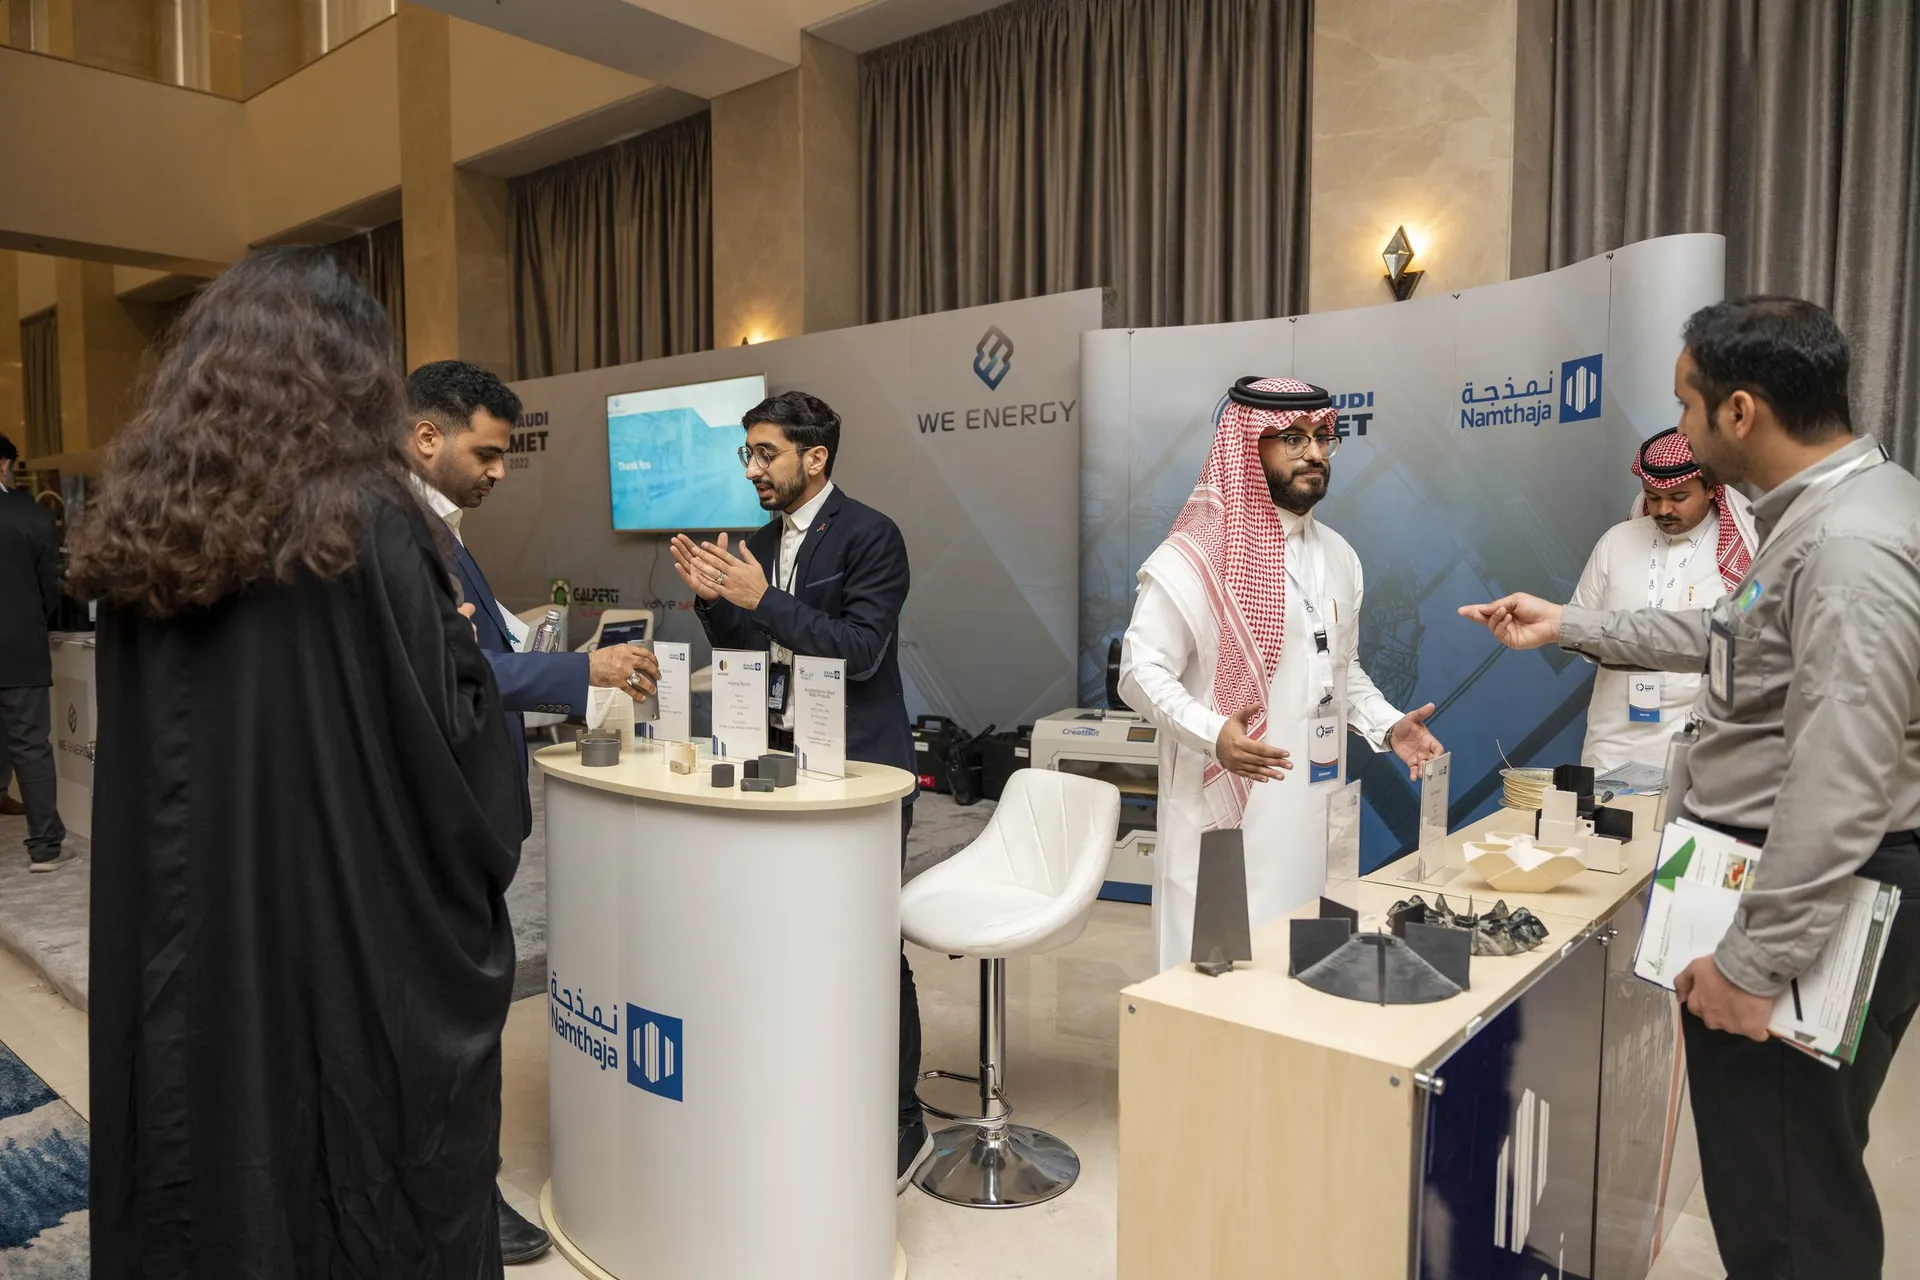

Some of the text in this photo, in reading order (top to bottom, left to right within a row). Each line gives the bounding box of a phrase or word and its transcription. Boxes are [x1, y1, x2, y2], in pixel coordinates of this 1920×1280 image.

[1330, 391, 1374, 409] UDI
[1461, 370, 1553, 406] نمذجة
[512, 411, 549, 428] AUDI
[917, 400, 1076, 434] WE ENERGY
[1333, 413, 1373, 436] ET
[1461, 400, 1552, 429] Namthaja
[509, 457, 530, 469] 2022
[551, 970, 618, 1036] نمذجة
[551, 1003, 618, 1071] Namthaja
